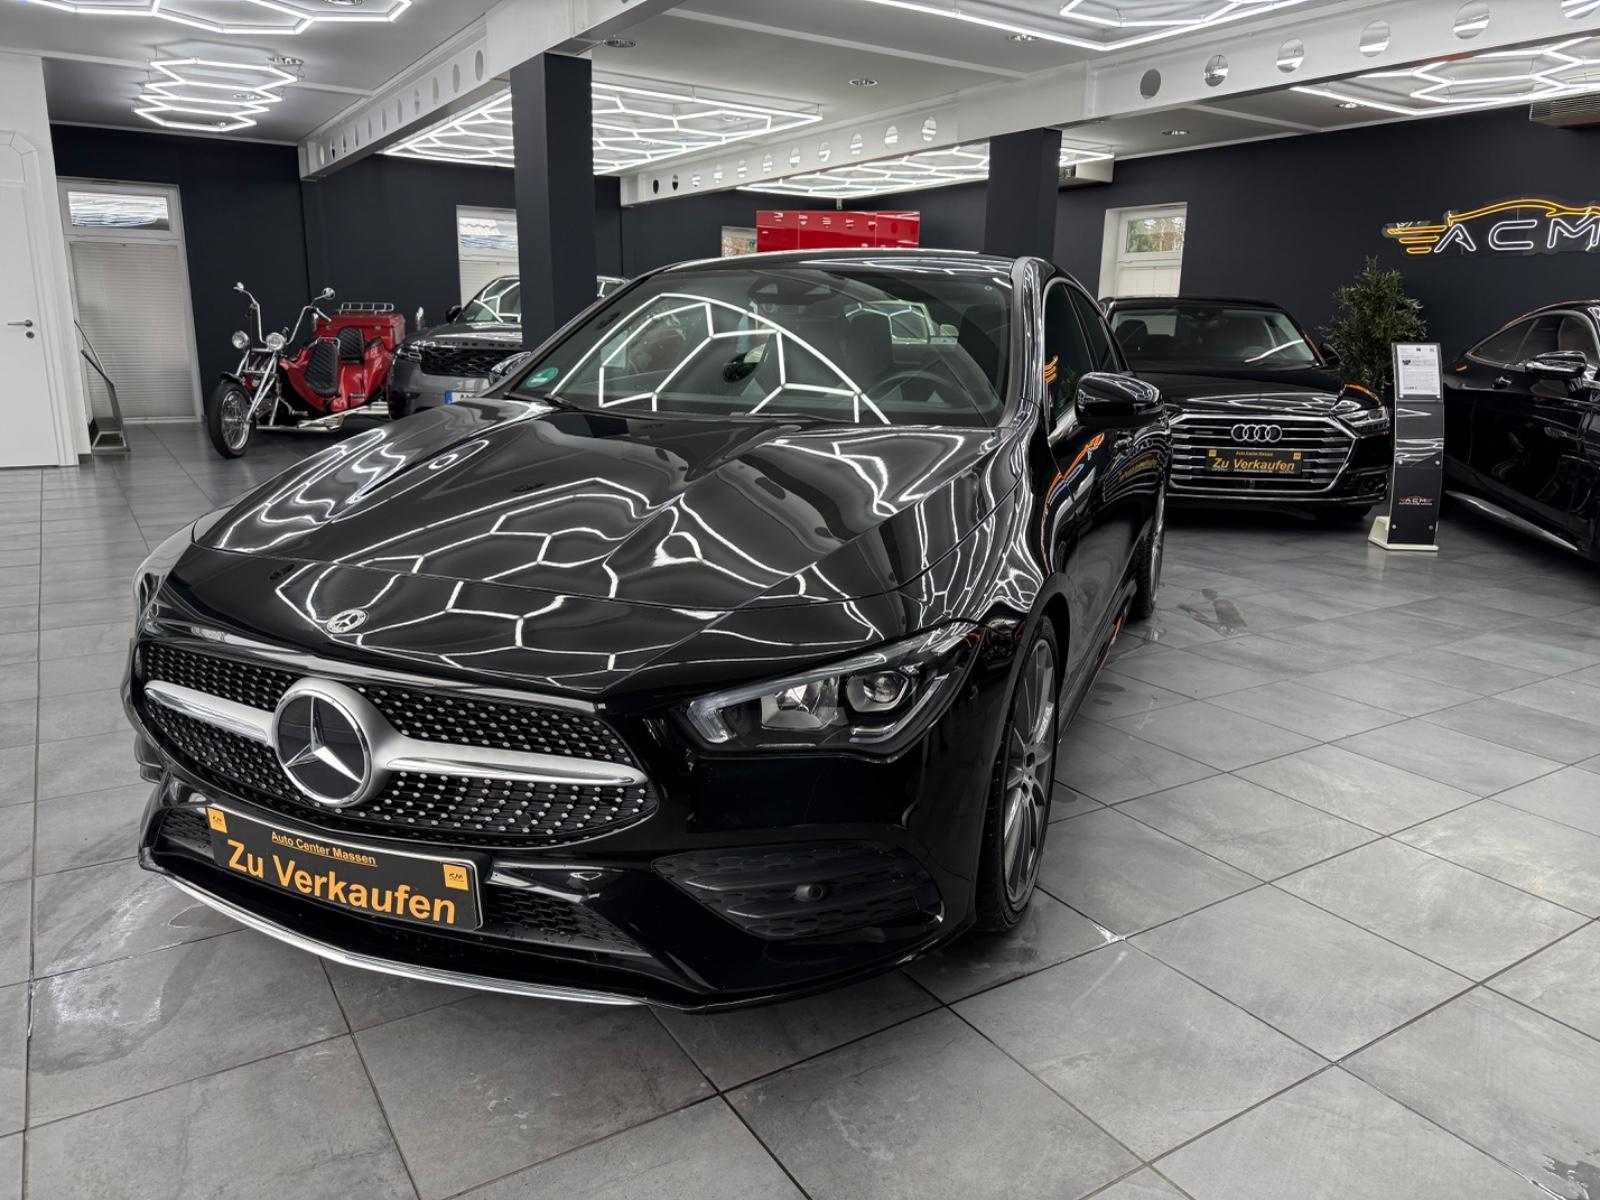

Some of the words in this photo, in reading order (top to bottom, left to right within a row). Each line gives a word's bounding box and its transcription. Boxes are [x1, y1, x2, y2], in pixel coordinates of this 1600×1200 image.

[1434, 216, 1600, 253] ACM
[1212, 457, 1229, 468] Zu
[1234, 459, 1295, 470] Verkaufen
[271, 831, 294, 847] Auto
[296, 838, 331, 856] Center
[332, 847, 377, 866] Massen
[227, 839, 264, 879] Zu
[272, 855, 456, 924] Verkaufen
